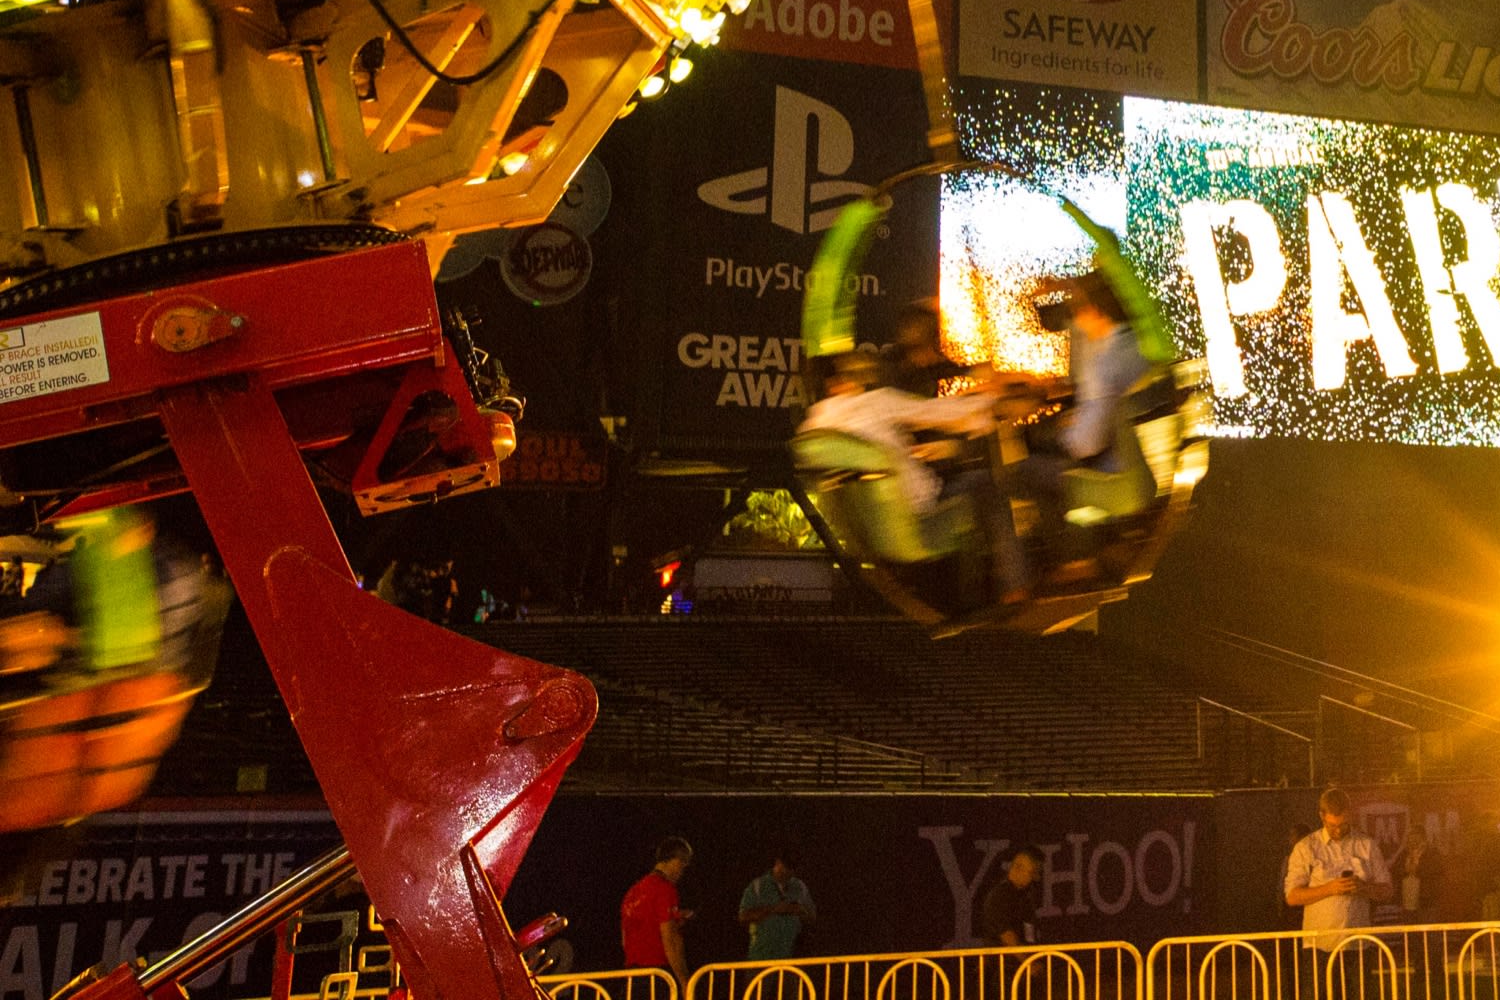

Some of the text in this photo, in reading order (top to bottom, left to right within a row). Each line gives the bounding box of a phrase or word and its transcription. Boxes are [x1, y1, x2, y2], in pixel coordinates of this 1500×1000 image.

[1003, 8, 1157, 54] SAFEWAY
[991, 47, 1165, 80] Ingredients for life
[8, 346, 41, 361] BRACE
[37, 357, 46, 369] IS
[9, 370, 42, 386] RESULT
[716, 371, 810, 409] AWA
[221, 851, 296, 896] THE
[917, 820, 1197, 950] YHOO!
